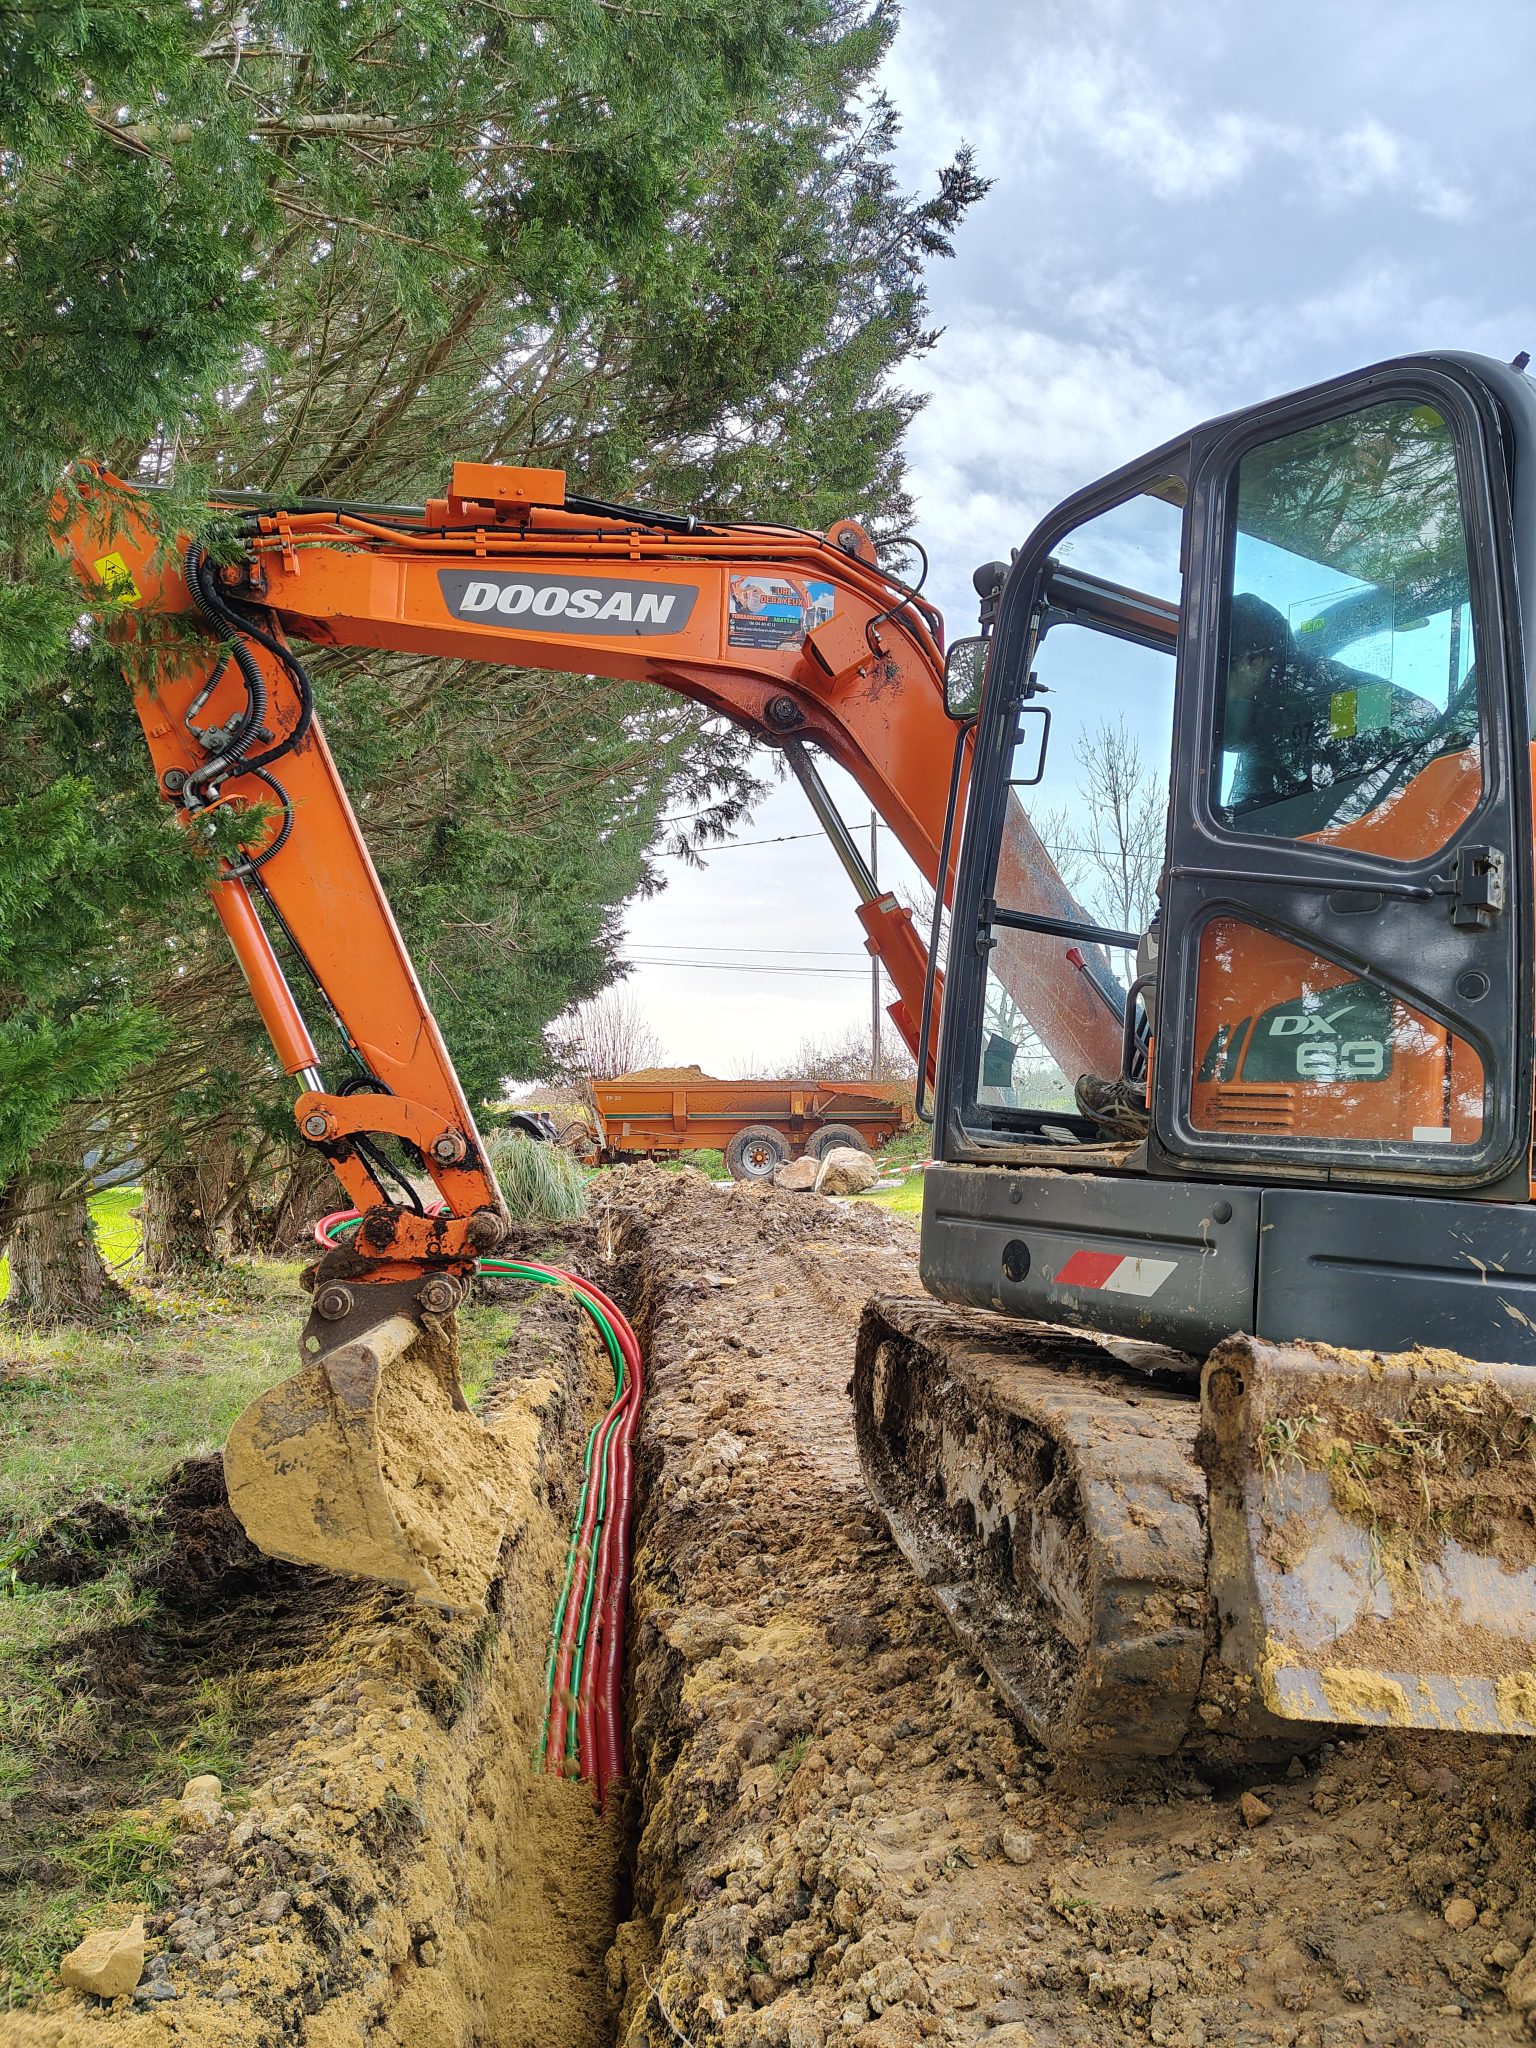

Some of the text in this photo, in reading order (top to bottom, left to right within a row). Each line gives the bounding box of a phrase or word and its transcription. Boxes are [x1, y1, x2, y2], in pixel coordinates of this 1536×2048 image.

[460, 582, 676, 623] DOOSAN
[1269, 1005, 1356, 1035] DX
[1296, 1041, 1384, 1075] 63
